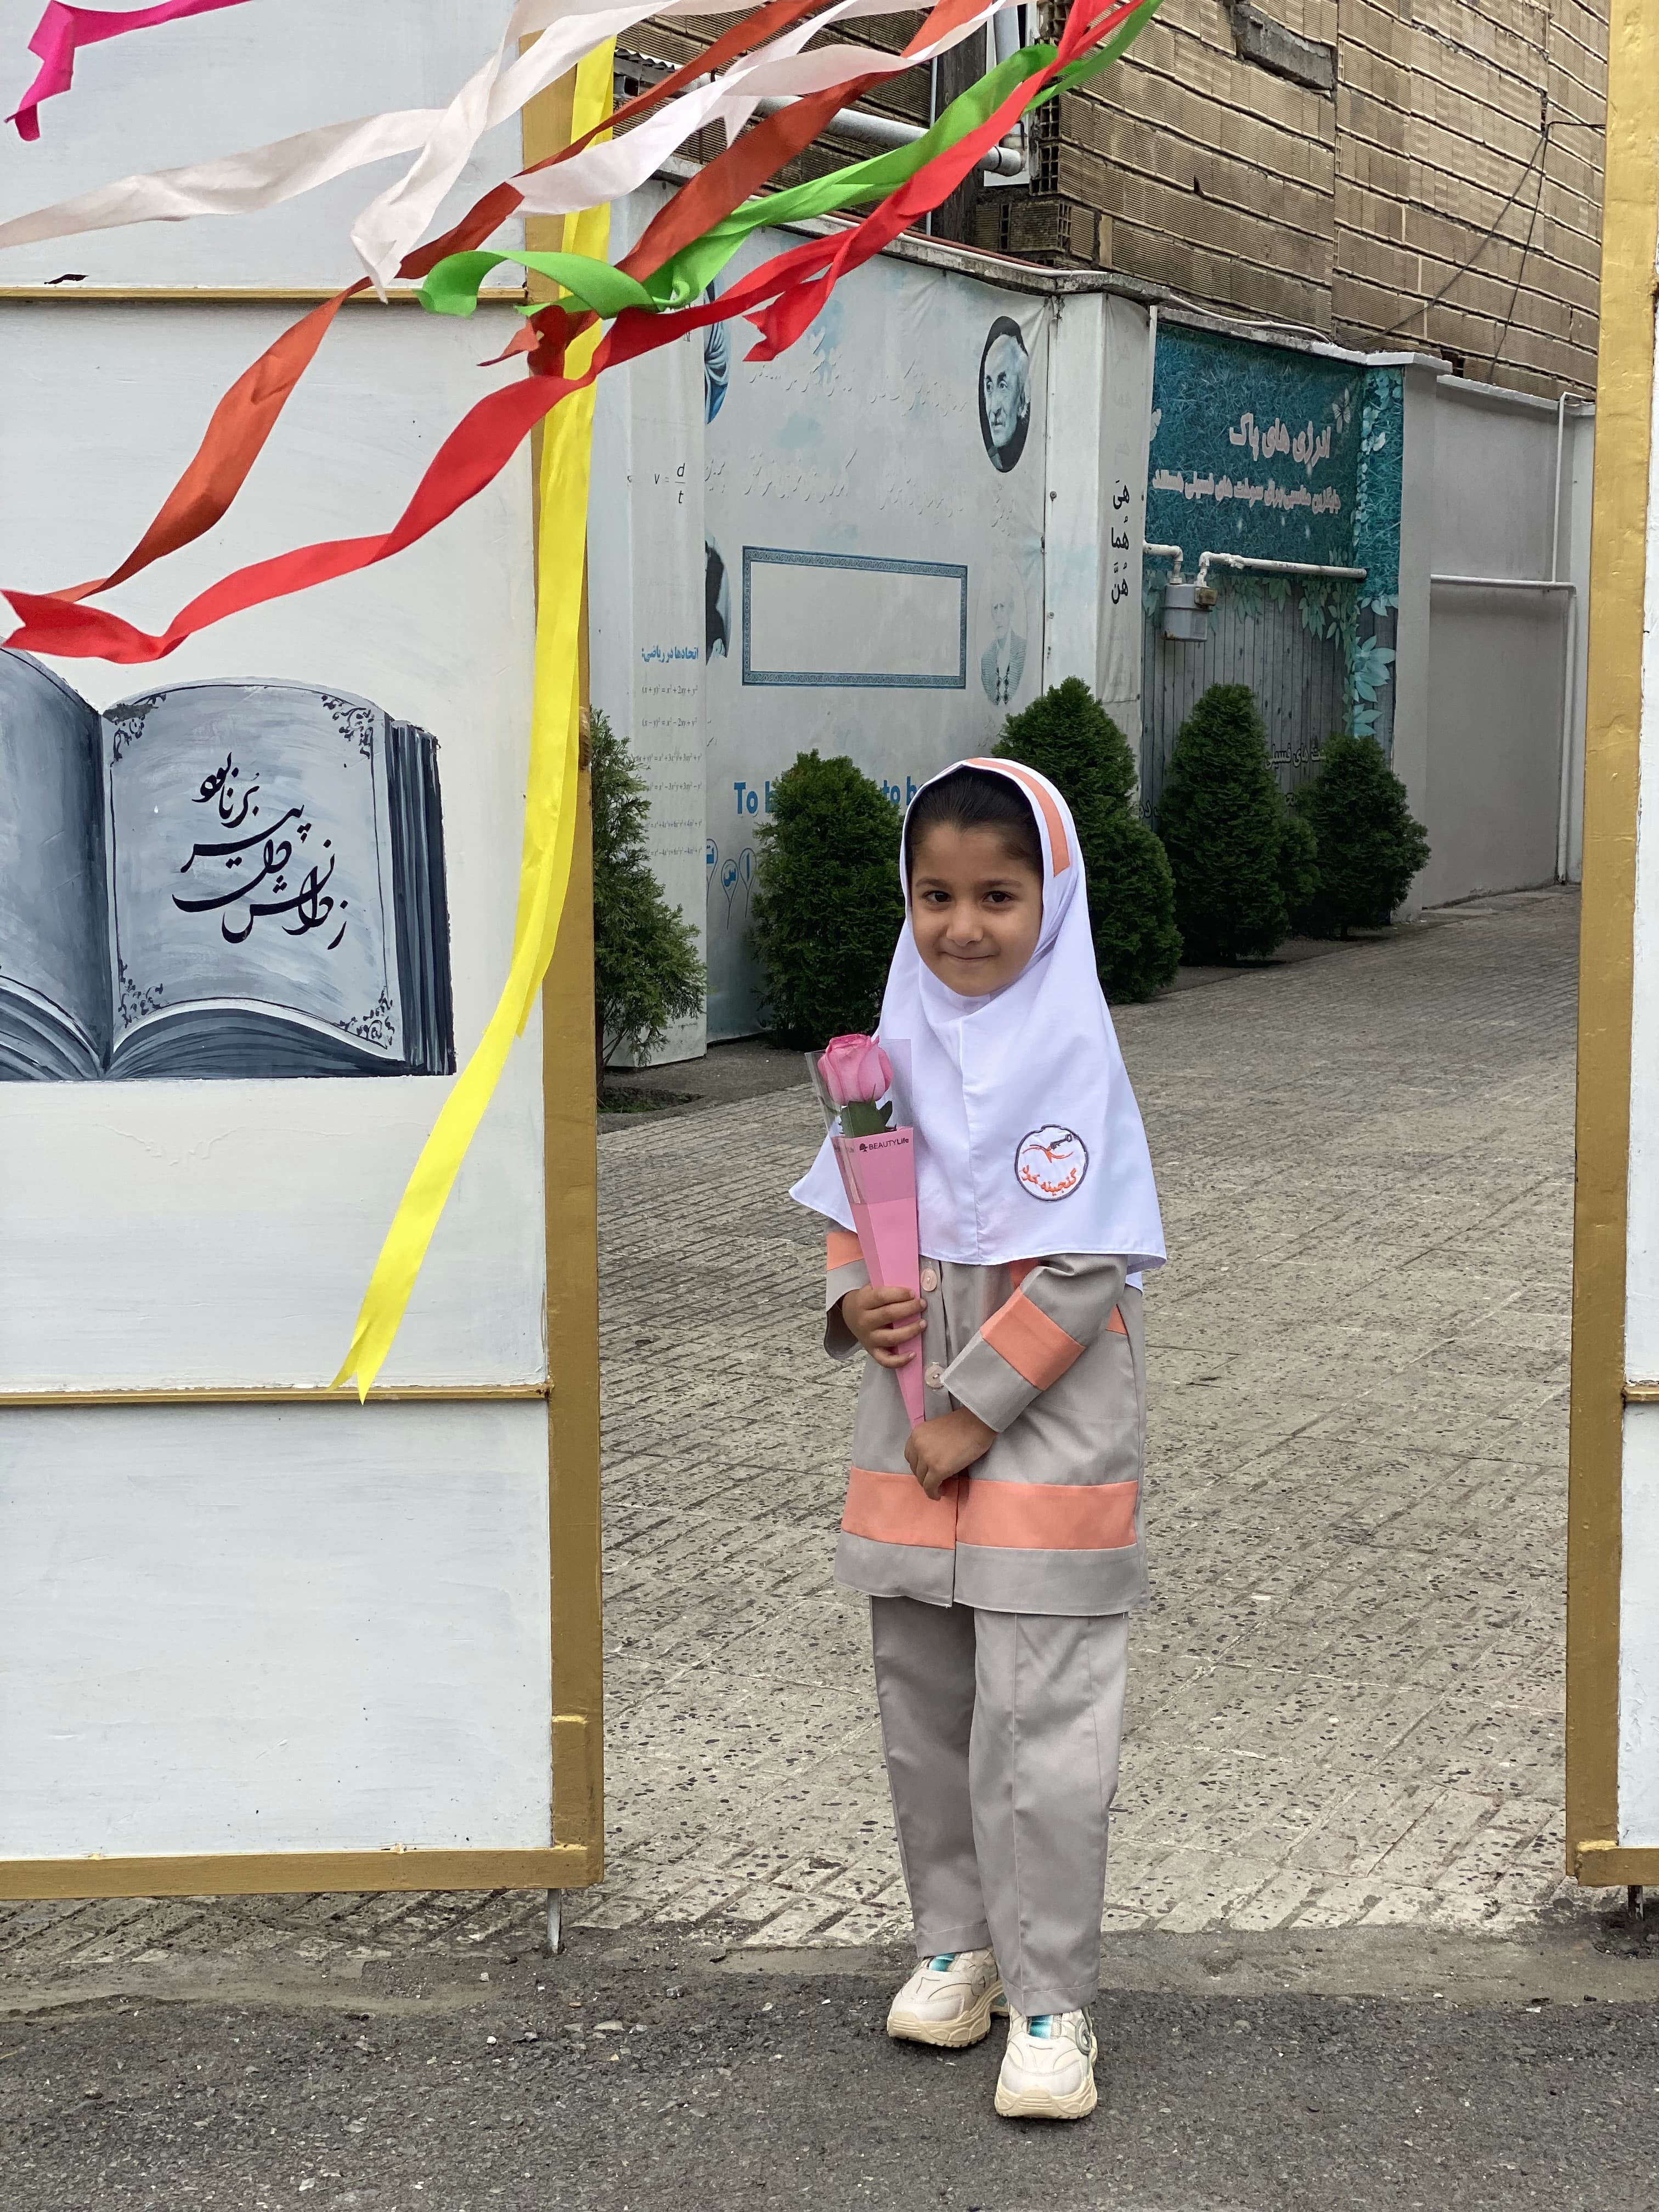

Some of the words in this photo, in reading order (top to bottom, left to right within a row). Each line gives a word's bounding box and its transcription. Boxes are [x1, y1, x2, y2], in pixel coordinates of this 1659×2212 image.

[1229, 413, 1260, 461] پاک
[1262, 417, 1289, 458] های
[734, 782, 758, 814] To
[882, 780, 900, 805] to
[906, 776, 923, 806] b
[1040, 1167, 1076, 1197] گنجینه
